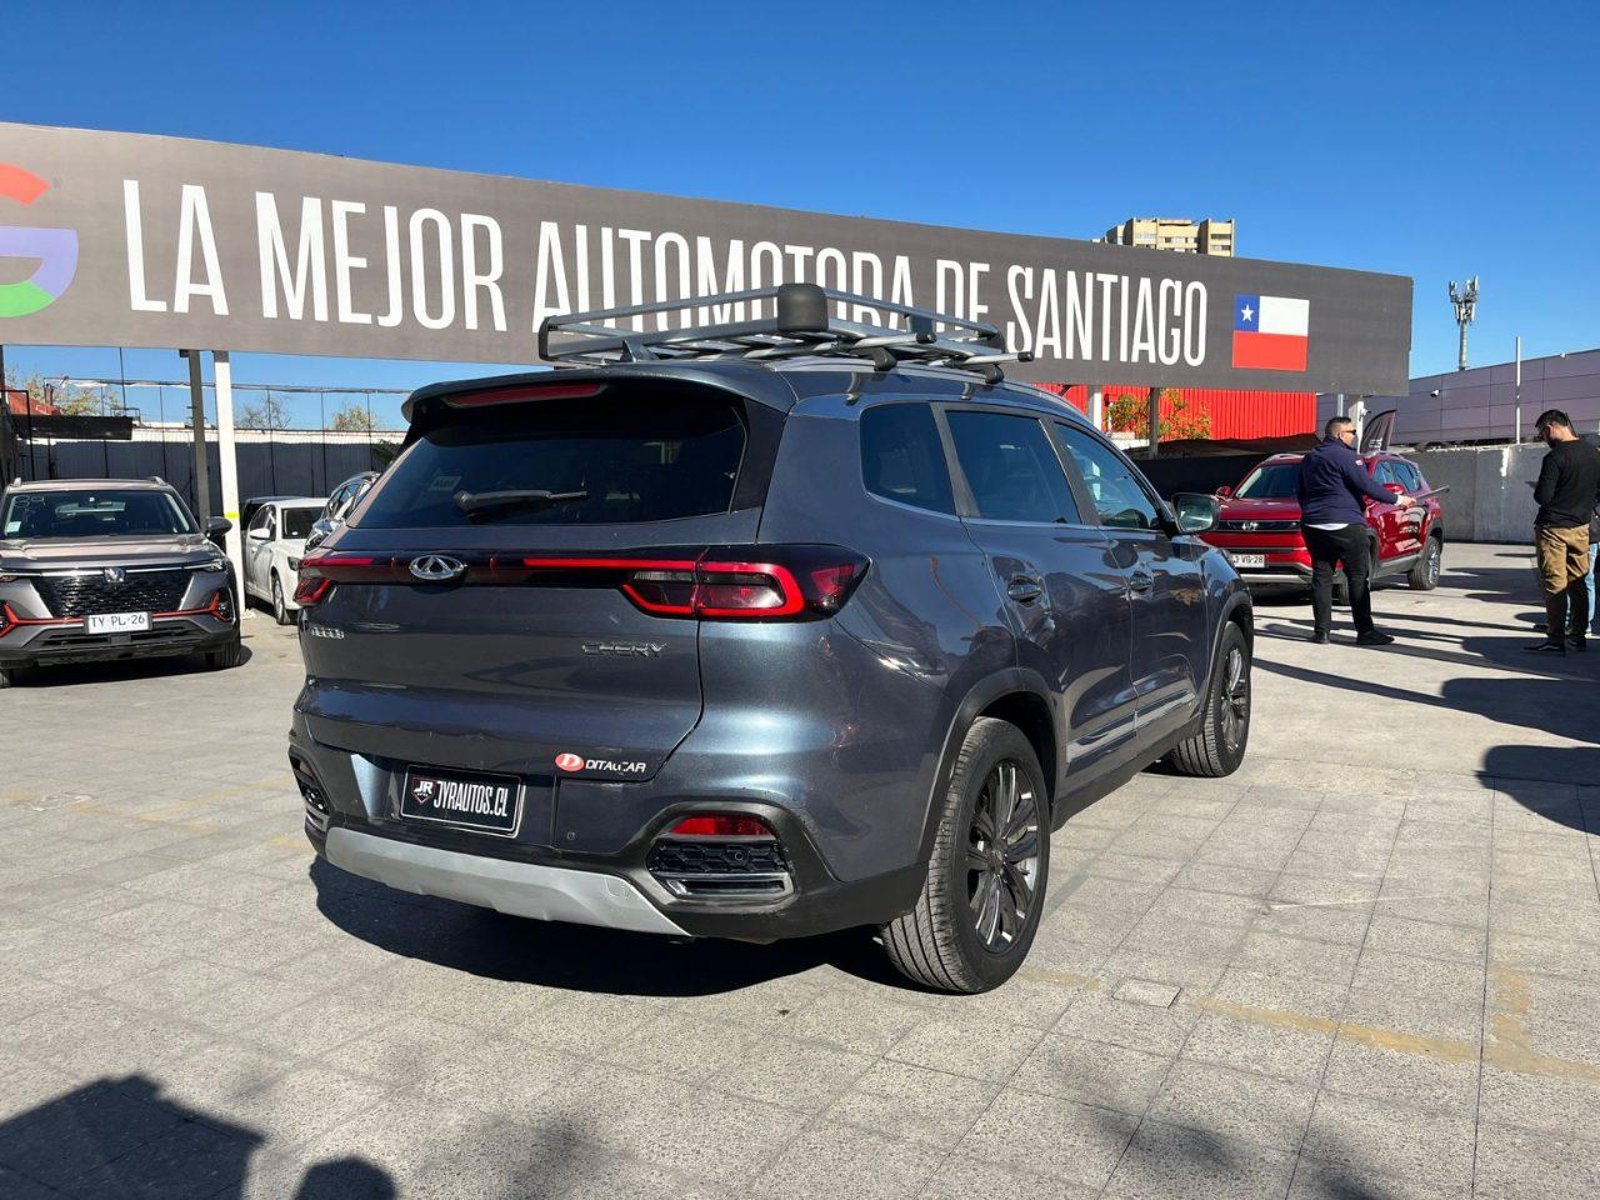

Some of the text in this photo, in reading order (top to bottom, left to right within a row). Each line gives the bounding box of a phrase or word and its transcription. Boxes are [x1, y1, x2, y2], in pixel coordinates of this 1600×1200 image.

[123, 179, 230, 315] LA
[255, 191, 508, 332] MEJOR
[532, 221, 915, 337] AUTOMOTORA
[1006, 265, 1208, 367] SANTIAGO
[433, 780, 509, 817] JYRAUTOS.CL
